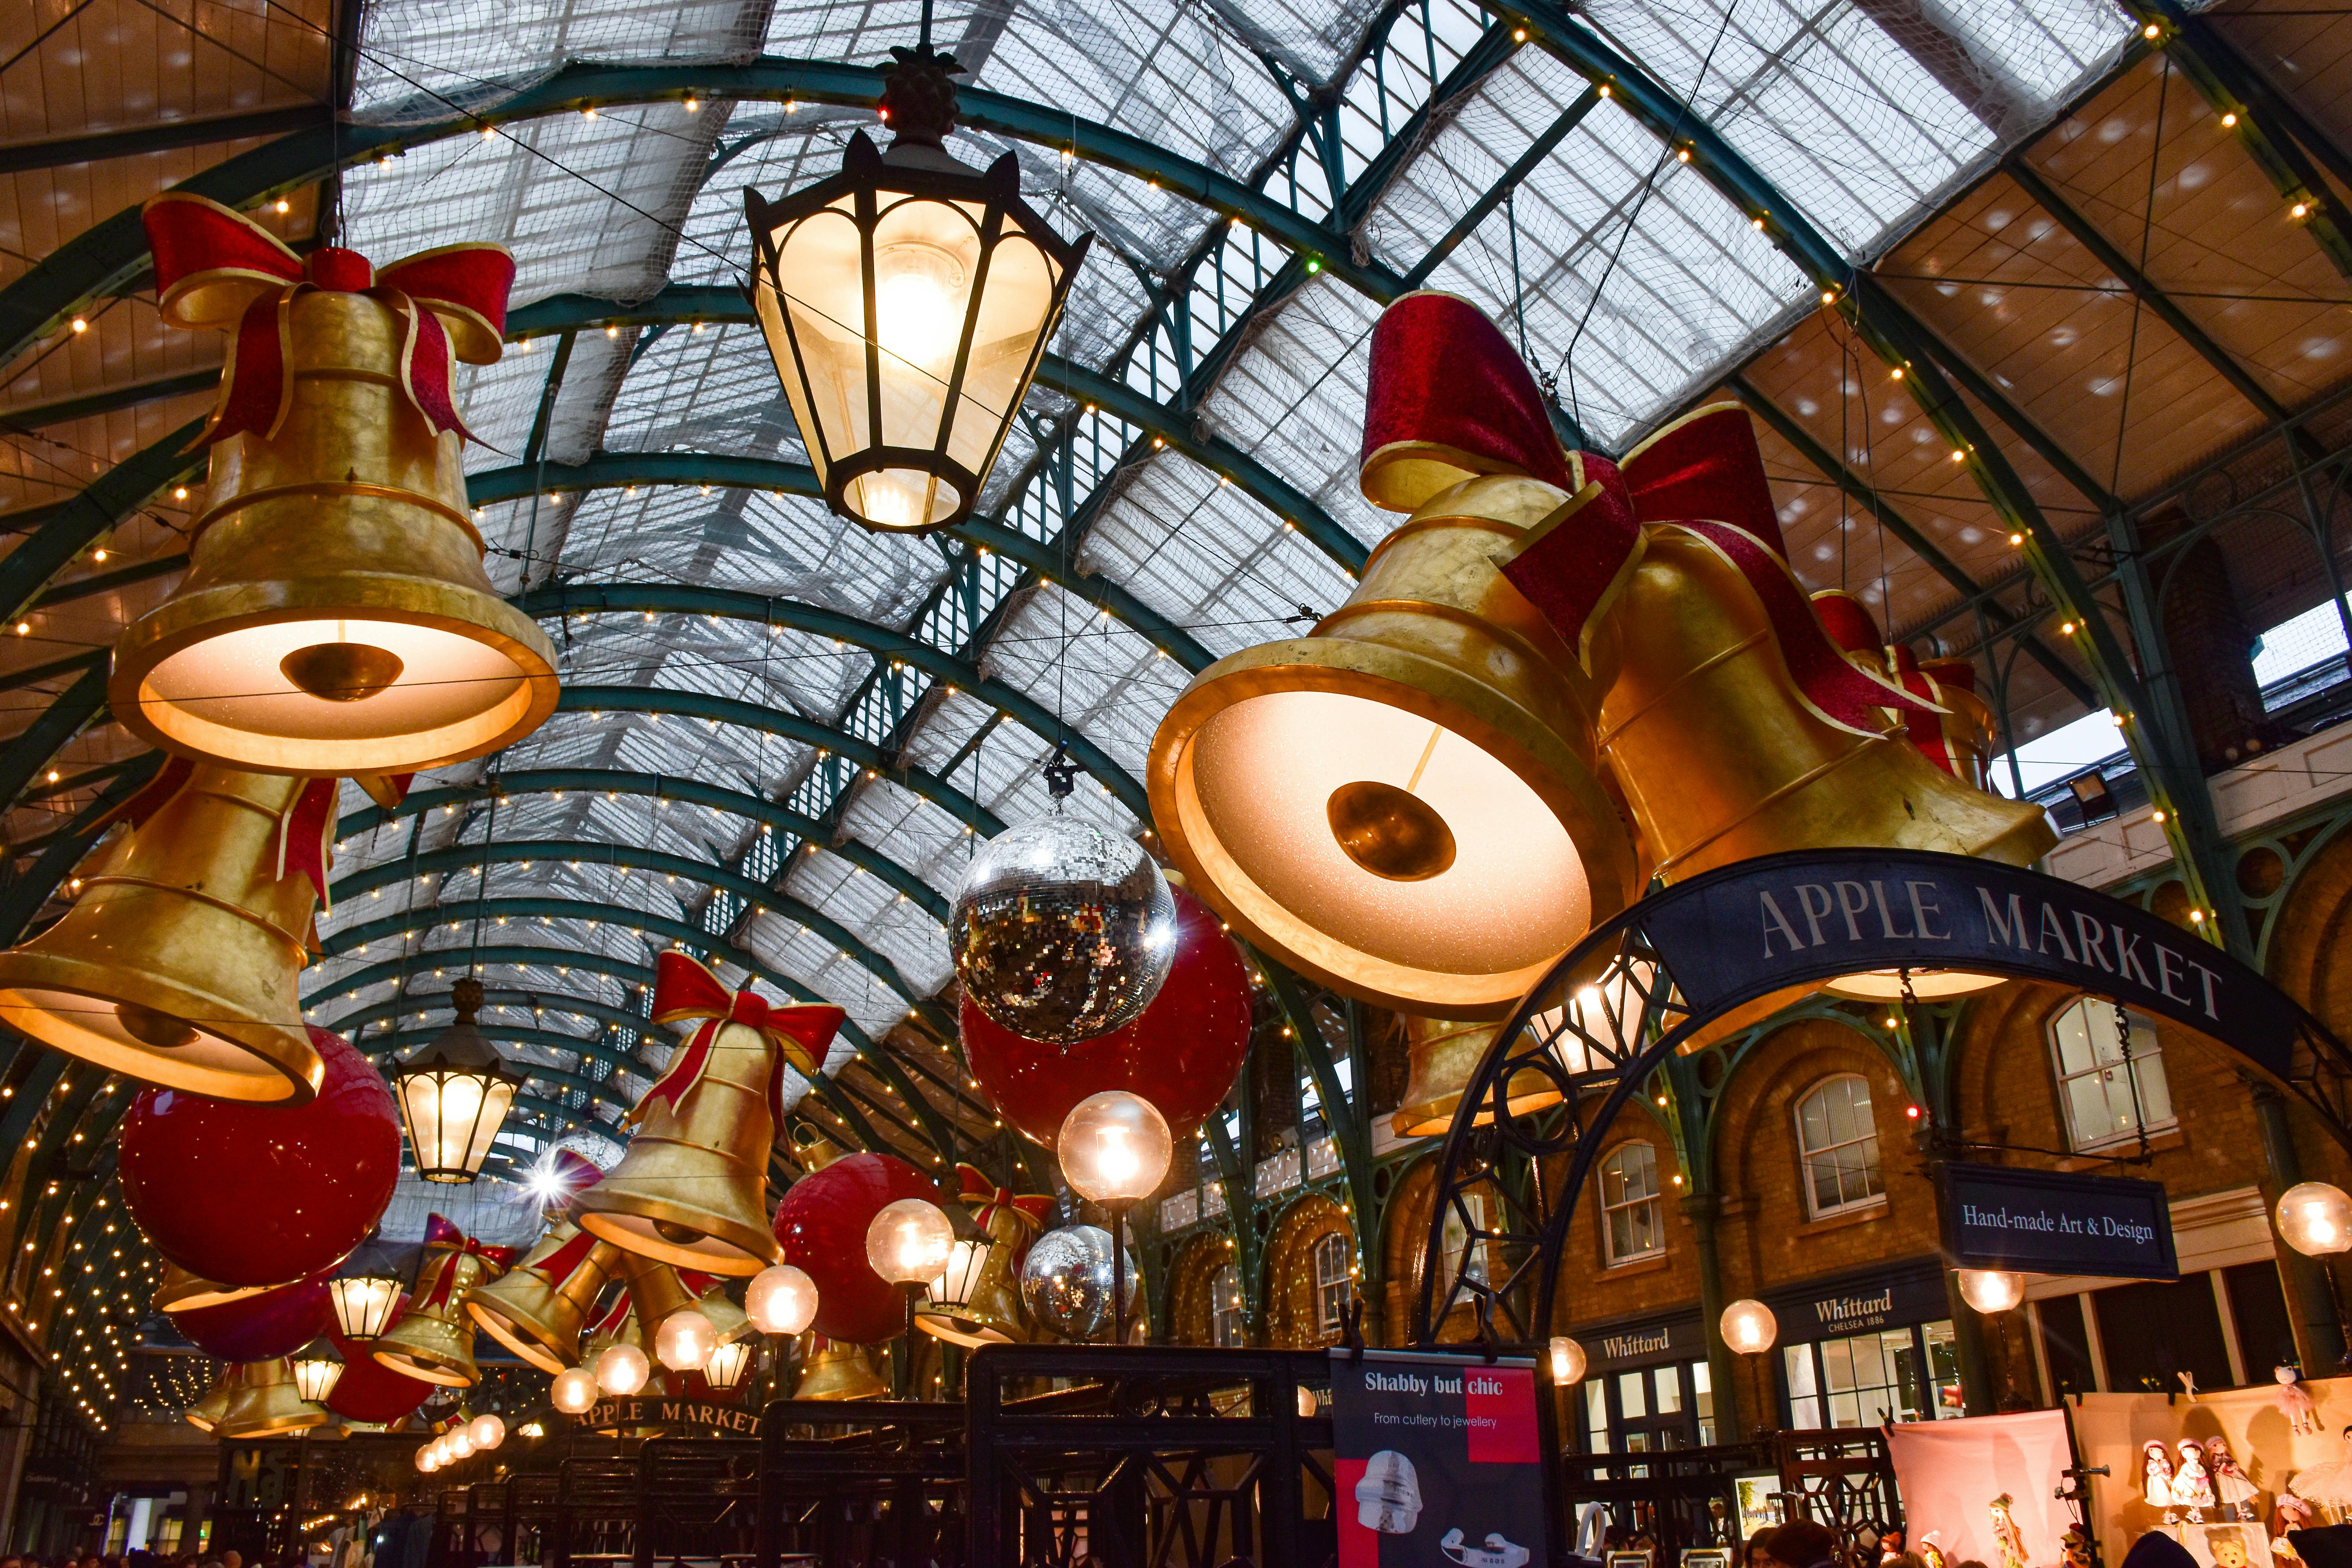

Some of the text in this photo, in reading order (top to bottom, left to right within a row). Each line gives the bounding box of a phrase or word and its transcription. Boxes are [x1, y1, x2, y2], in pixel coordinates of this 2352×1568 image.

[1759, 880, 2222, 1022] APPLE MARKET
[1963, 1205, 2153, 1244] Hand-made Art & Design
[1815, 1288, 1893, 1323] Whittard
[1828, 1315, 1884, 1333] CHELSEA 1886
[1603, 1327, 1670, 1359] Whittard
[1365, 1372, 1503, 1396] Shabby but chic
[661, 1403, 762, 1435] MARKET
[1374, 1413, 1497, 1430] From cutlery to jewellery
